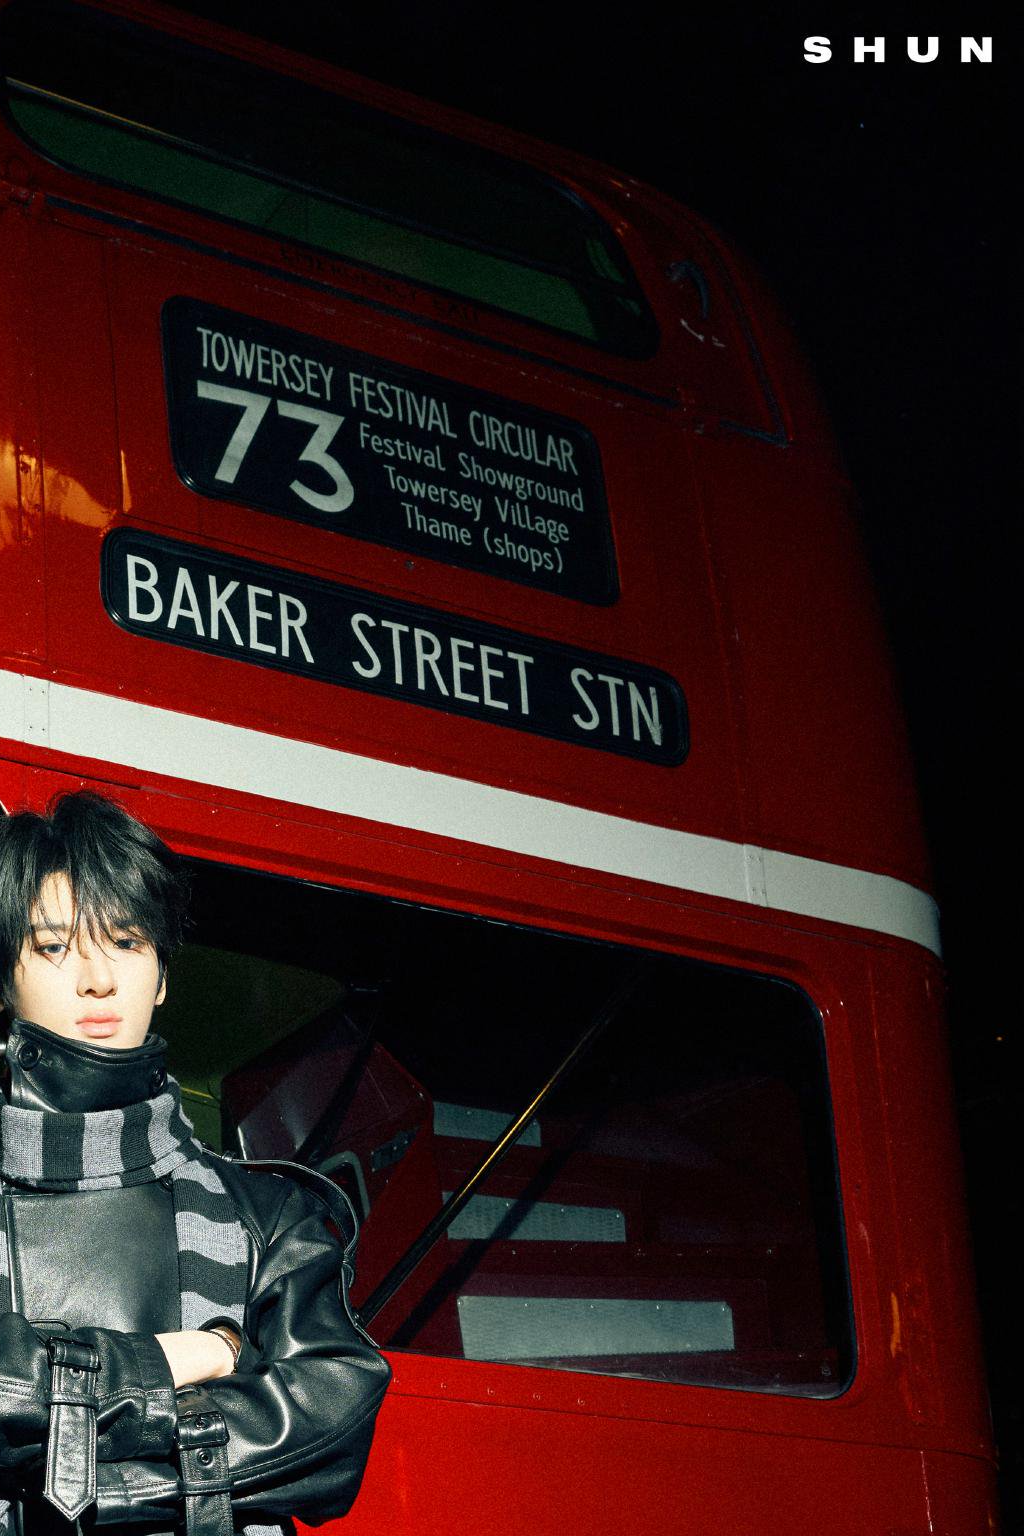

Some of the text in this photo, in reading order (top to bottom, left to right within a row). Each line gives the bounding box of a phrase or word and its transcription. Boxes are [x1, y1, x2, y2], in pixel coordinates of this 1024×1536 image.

[196, 326, 579, 476] TOWERSEY FESTIVAL CIRCULAR
[196, 379, 355, 513] 73
[359, 422, 584, 513] Festival Showground
[383, 464, 570, 544] Towersey Village
[400, 502, 564, 574] Thame (shops)
[125, 553, 663, 747] BAKER STREET STN
